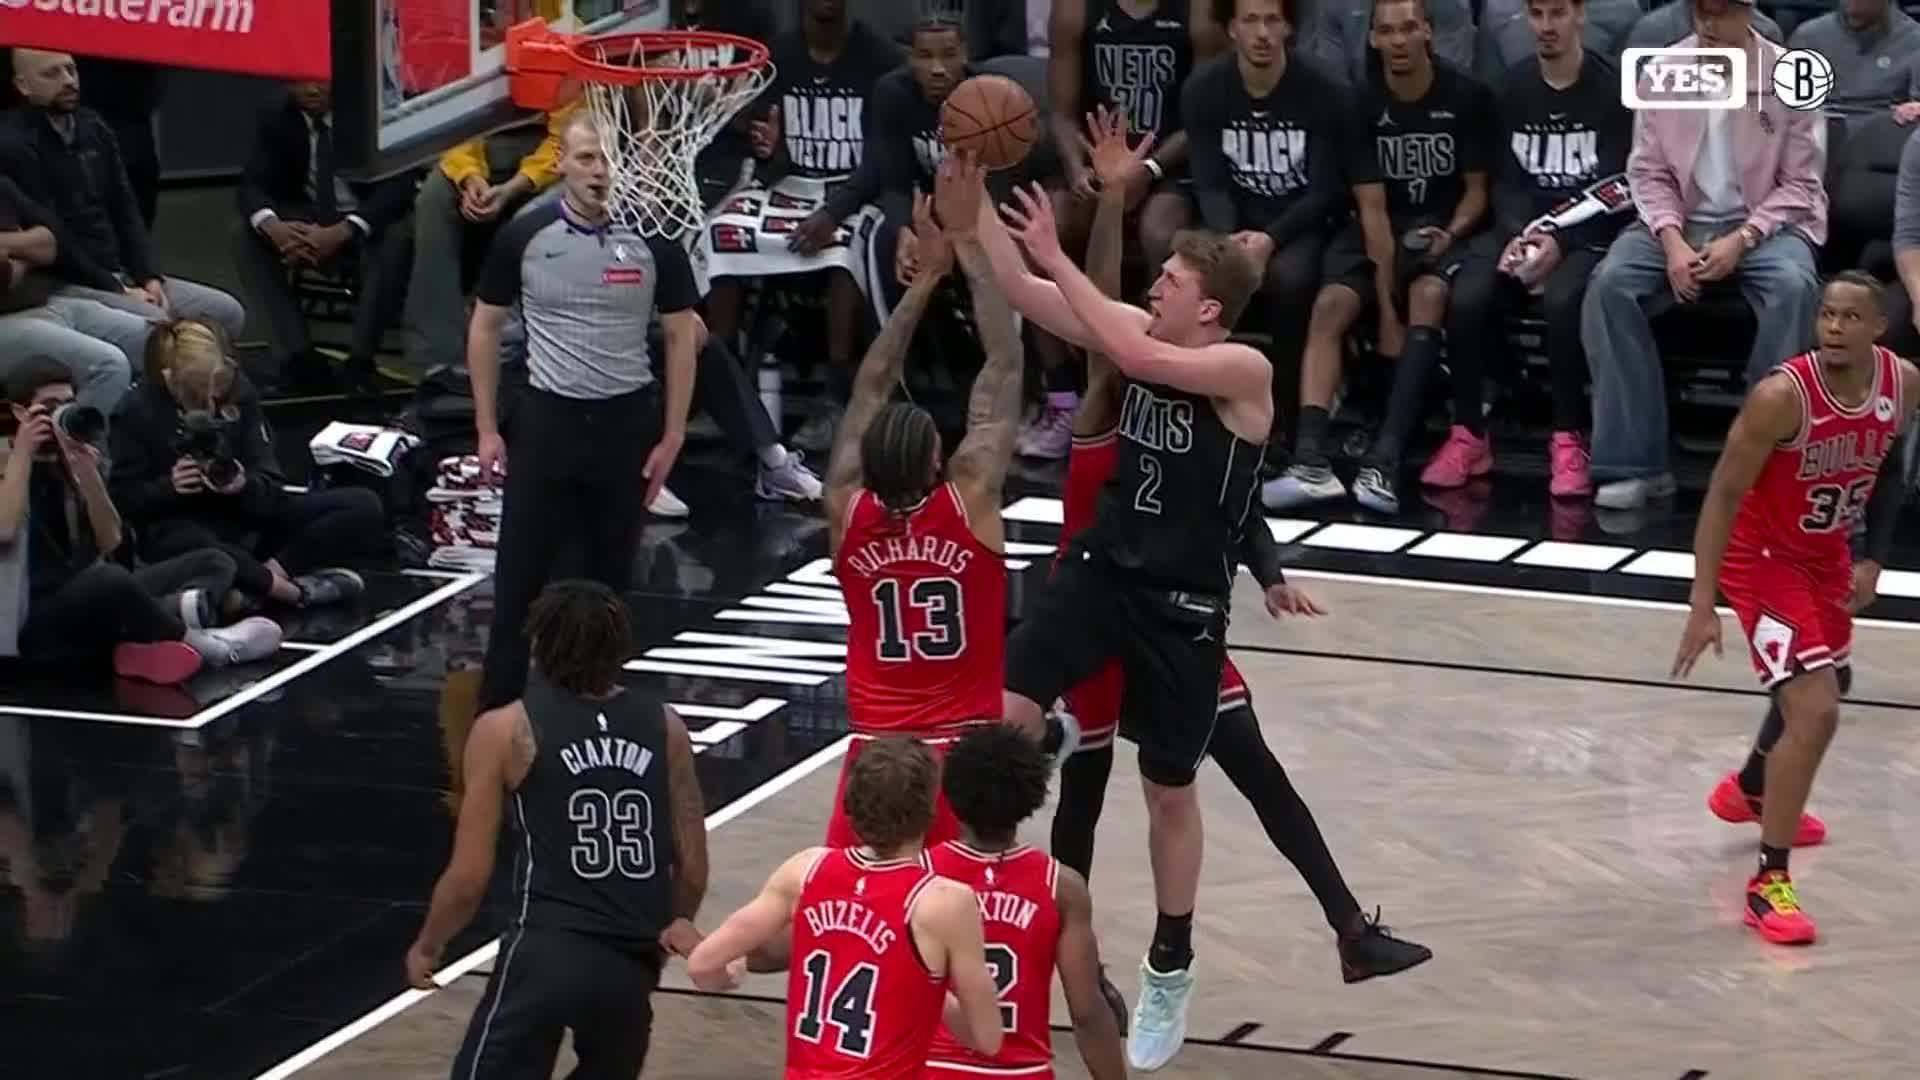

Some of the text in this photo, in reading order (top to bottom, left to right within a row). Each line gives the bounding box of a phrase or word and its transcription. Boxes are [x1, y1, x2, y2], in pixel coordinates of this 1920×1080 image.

[33, 0, 252, 33] ateFarm
[1095, 44, 1176, 87] NETS
[783, 94, 864, 141] BLACK
[1222, 127, 1307, 174] BLACK
[1376, 133, 1455, 179] NETS
[1511, 130, 1599, 175] BLACK
[1134, 453, 1162, 515] 2
[1798, 475, 1877, 534] 35
[848, 535, 974, 578] RICHARDS
[871, 576, 967, 662] 13
[559, 736, 653, 778] CLAXTON
[568, 787, 656, 879] 33
[803, 899, 897, 955] BUZELIS
[976, 890, 1039, 931] XTON
[794, 948, 879, 1060] 14
